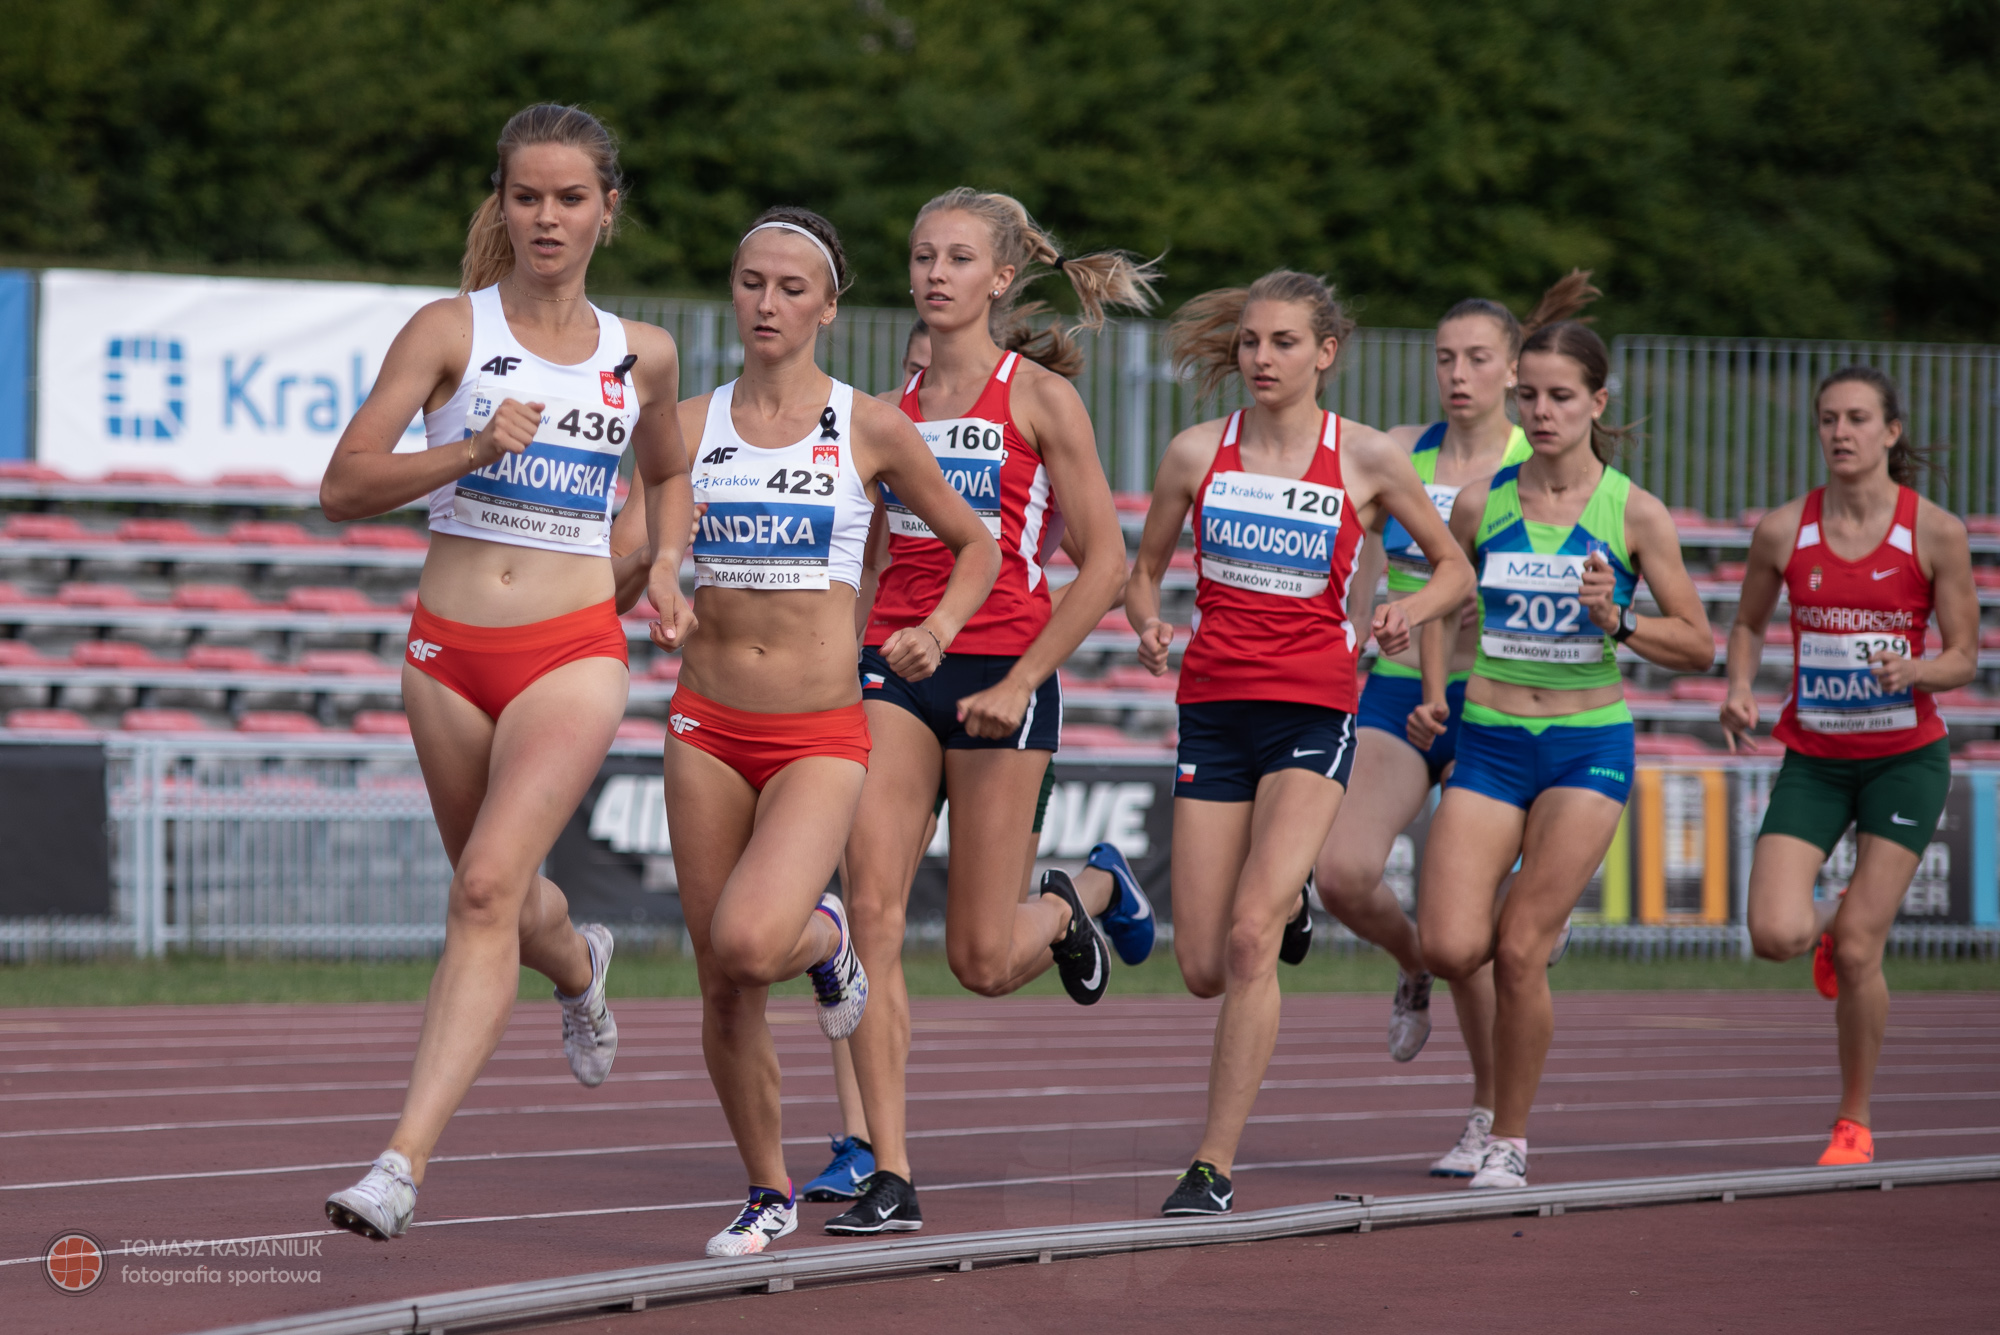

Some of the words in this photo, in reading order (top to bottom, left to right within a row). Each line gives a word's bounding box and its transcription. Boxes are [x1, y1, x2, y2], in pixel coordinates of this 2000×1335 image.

[481, 356, 522, 376] 4F
[557, 408, 626, 445] 436
[946, 425, 1001, 451] 160
[702, 447, 738, 465] 4F
[711, 474, 760, 488] Kraków
[766, 468, 835, 496] 423
[1230, 485, 1274, 500] Kraków
[1282, 487, 1340, 517] 120
[481, 510, 546, 533] KRAKÓW
[549, 523, 581, 538] 2018
[702, 515, 815, 545] INDEKA
[1206, 517, 1329, 561] KALOUSOVÁ
[715, 569, 765, 583] KRAKÓW
[769, 572, 800, 584] 2018
[1222, 570, 1271, 587] KRAKÓW
[1274, 579, 1302, 593] 2018
[1508, 561, 1580, 579] MZLA
[1506, 593, 1581, 632] 202
[409, 639, 442, 662] 4F
[670, 713, 701, 735] 4F
